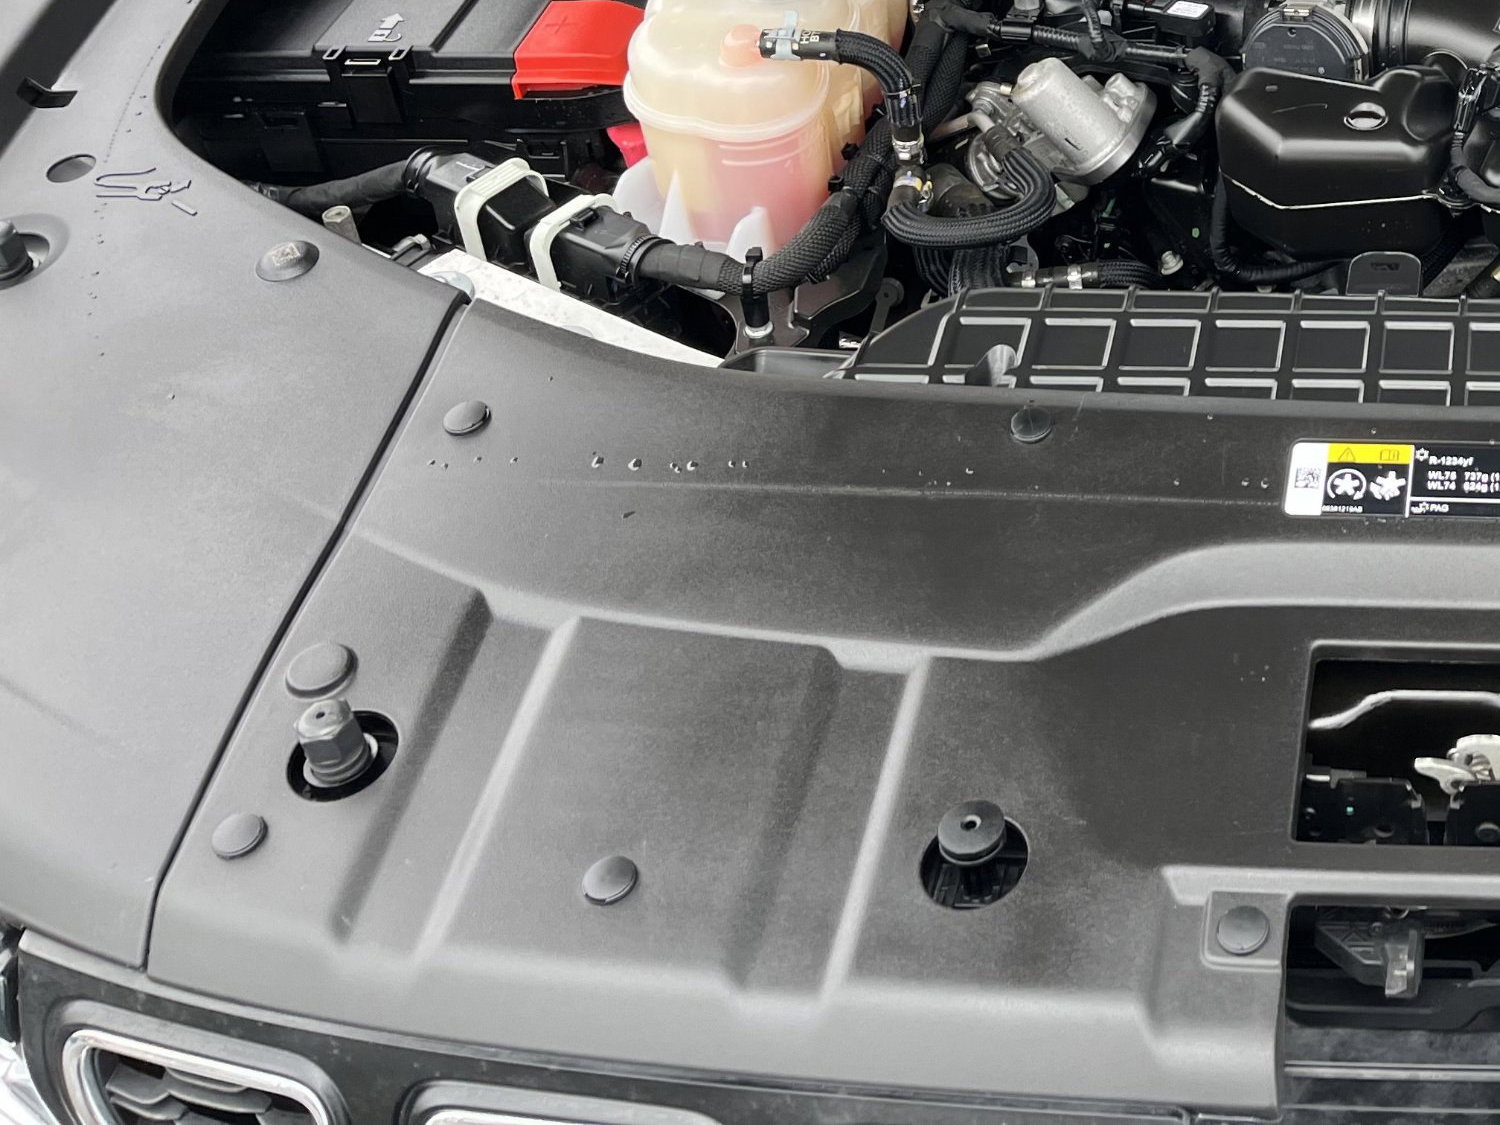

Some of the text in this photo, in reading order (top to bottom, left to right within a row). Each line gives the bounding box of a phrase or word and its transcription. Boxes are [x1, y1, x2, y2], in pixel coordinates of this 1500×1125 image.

[1429, 456, 1474, 467] R-1234yf
[1428, 471, 1456, 480] WL75
[1464, 472, 1488, 482] 737g
[1427, 481, 1456, 490] WL74
[1463, 482, 1488, 492] 624g
[1430, 504, 1449, 513] PAG
